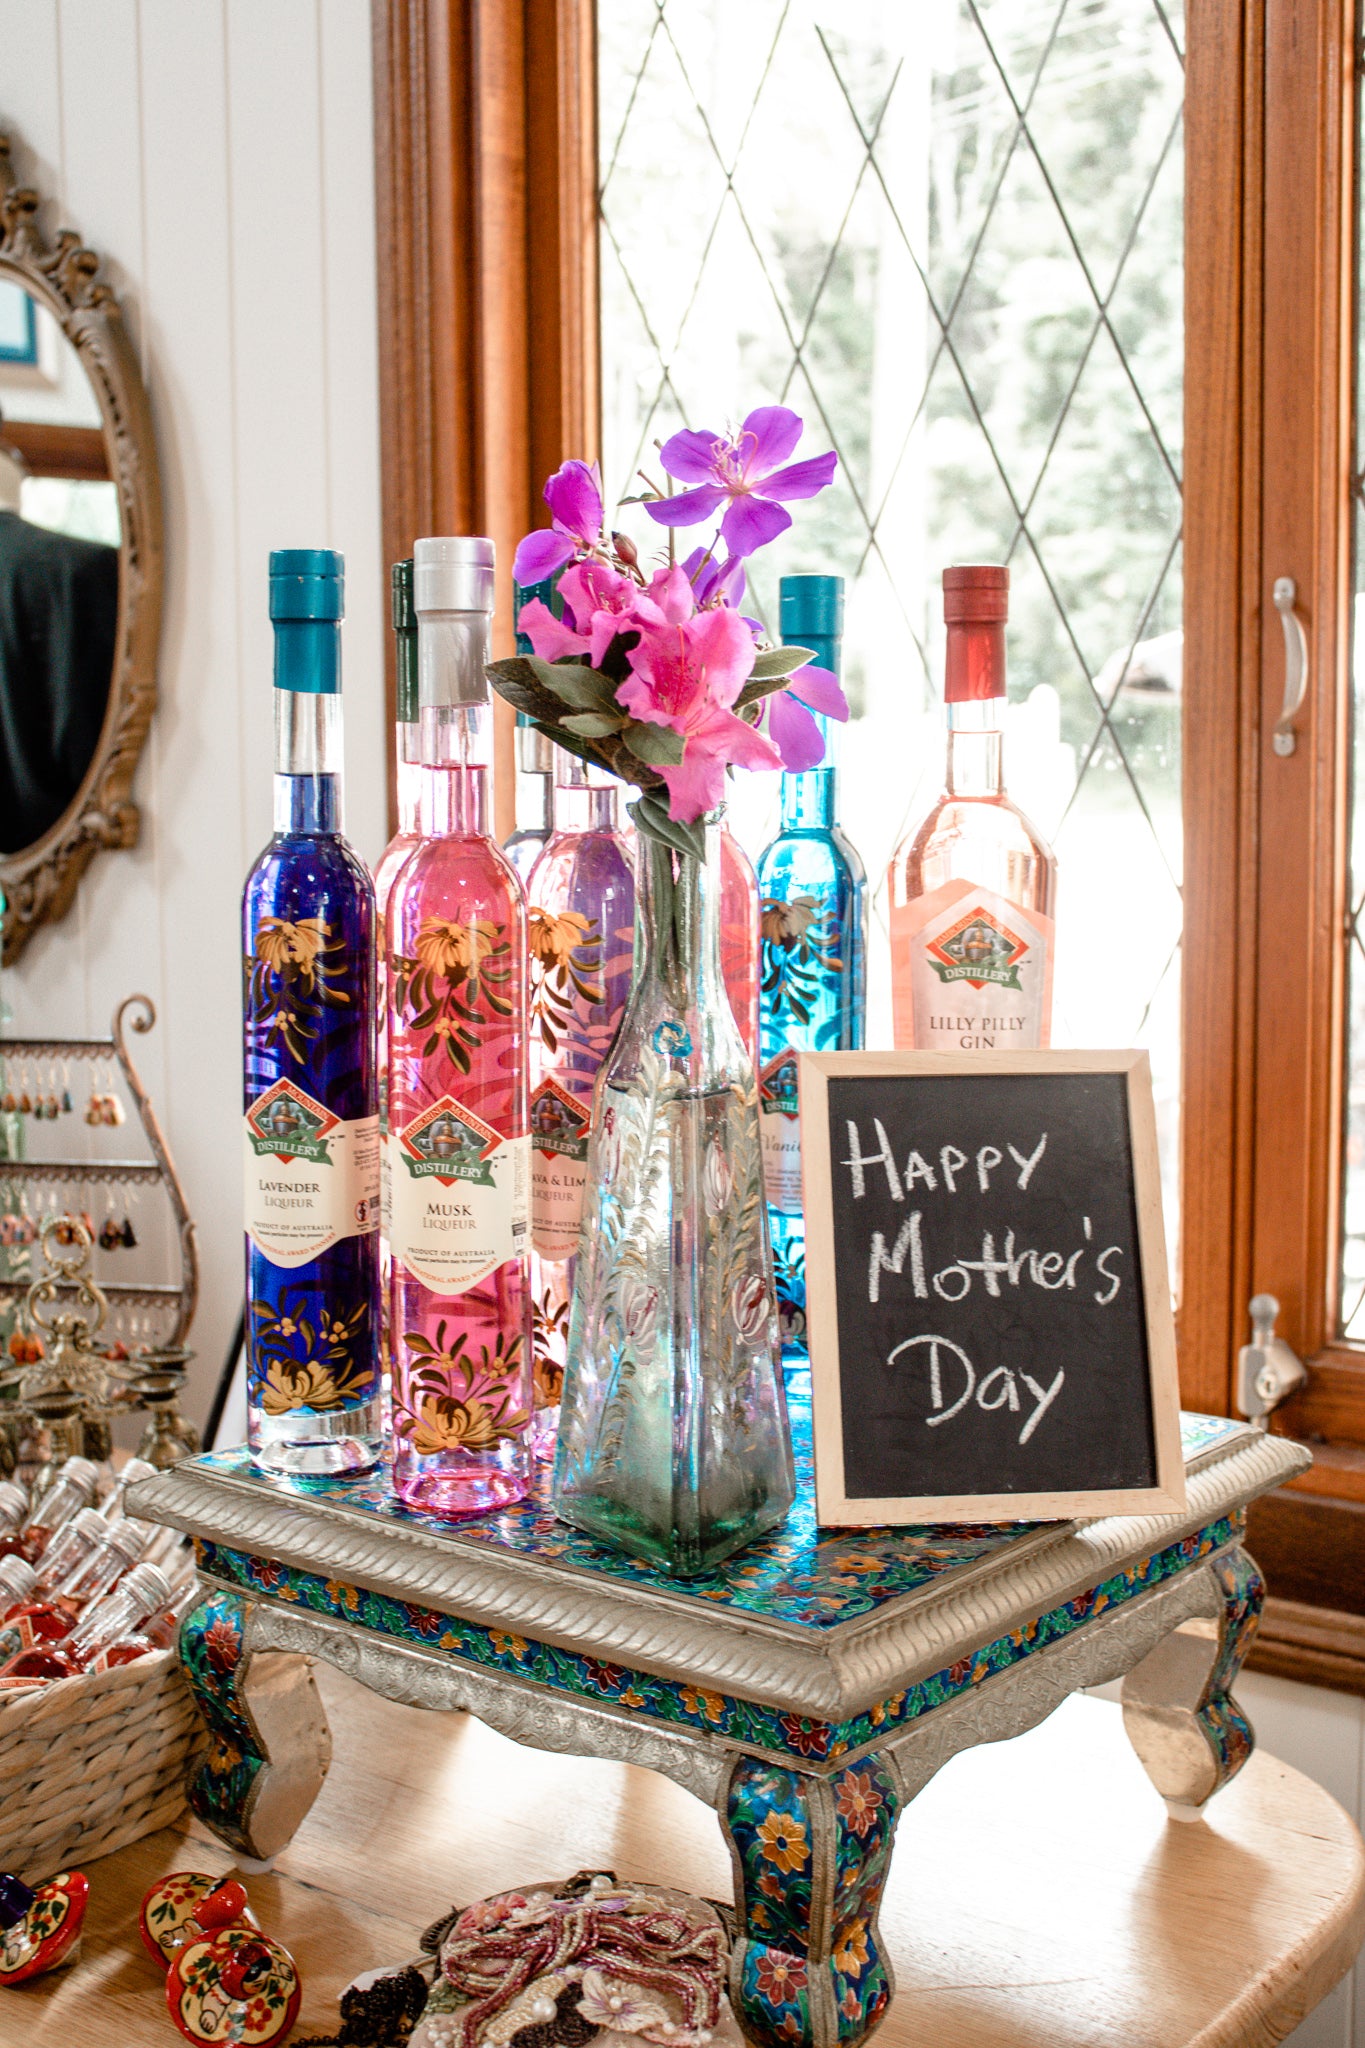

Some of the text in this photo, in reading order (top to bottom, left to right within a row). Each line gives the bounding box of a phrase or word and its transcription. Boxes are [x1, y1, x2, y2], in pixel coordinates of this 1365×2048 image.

[944, 966, 1012, 982] DISTILLERY
[930, 1016, 1027, 1031] LILLY PILLY
[959, 1036, 996, 1049] GIN
[287, 1085, 330, 1120] MOUNTAIN
[404, 1104, 444, 1138] TAMBORINE
[449, 1104, 494, 1139] MOUNTAIN
[257, 1141, 320, 1157] DISTILLERY
[413, 1162, 484, 1178] DISTILLERY
[259, 1179, 320, 1193] LAVENDER
[551, 1174, 560, 1186] &
[563, 1175, 586, 1187] LIM
[532, 1187, 575, 1201] LIQUEUR
[264, 1195, 315, 1209] LIQUEUR
[426, 1203, 473, 1217] MUSK
[422, 1216, 478, 1231] LIQUEUR
[407, 1247, 438, 1256] PRODUCT
[453, 1249, 496, 1257] AUSTRALIA
[868, 1209, 1124, 1306] Mother's
[447, 1275, 471, 1284] AWARD
[886, 1333, 1065, 1445] Day
